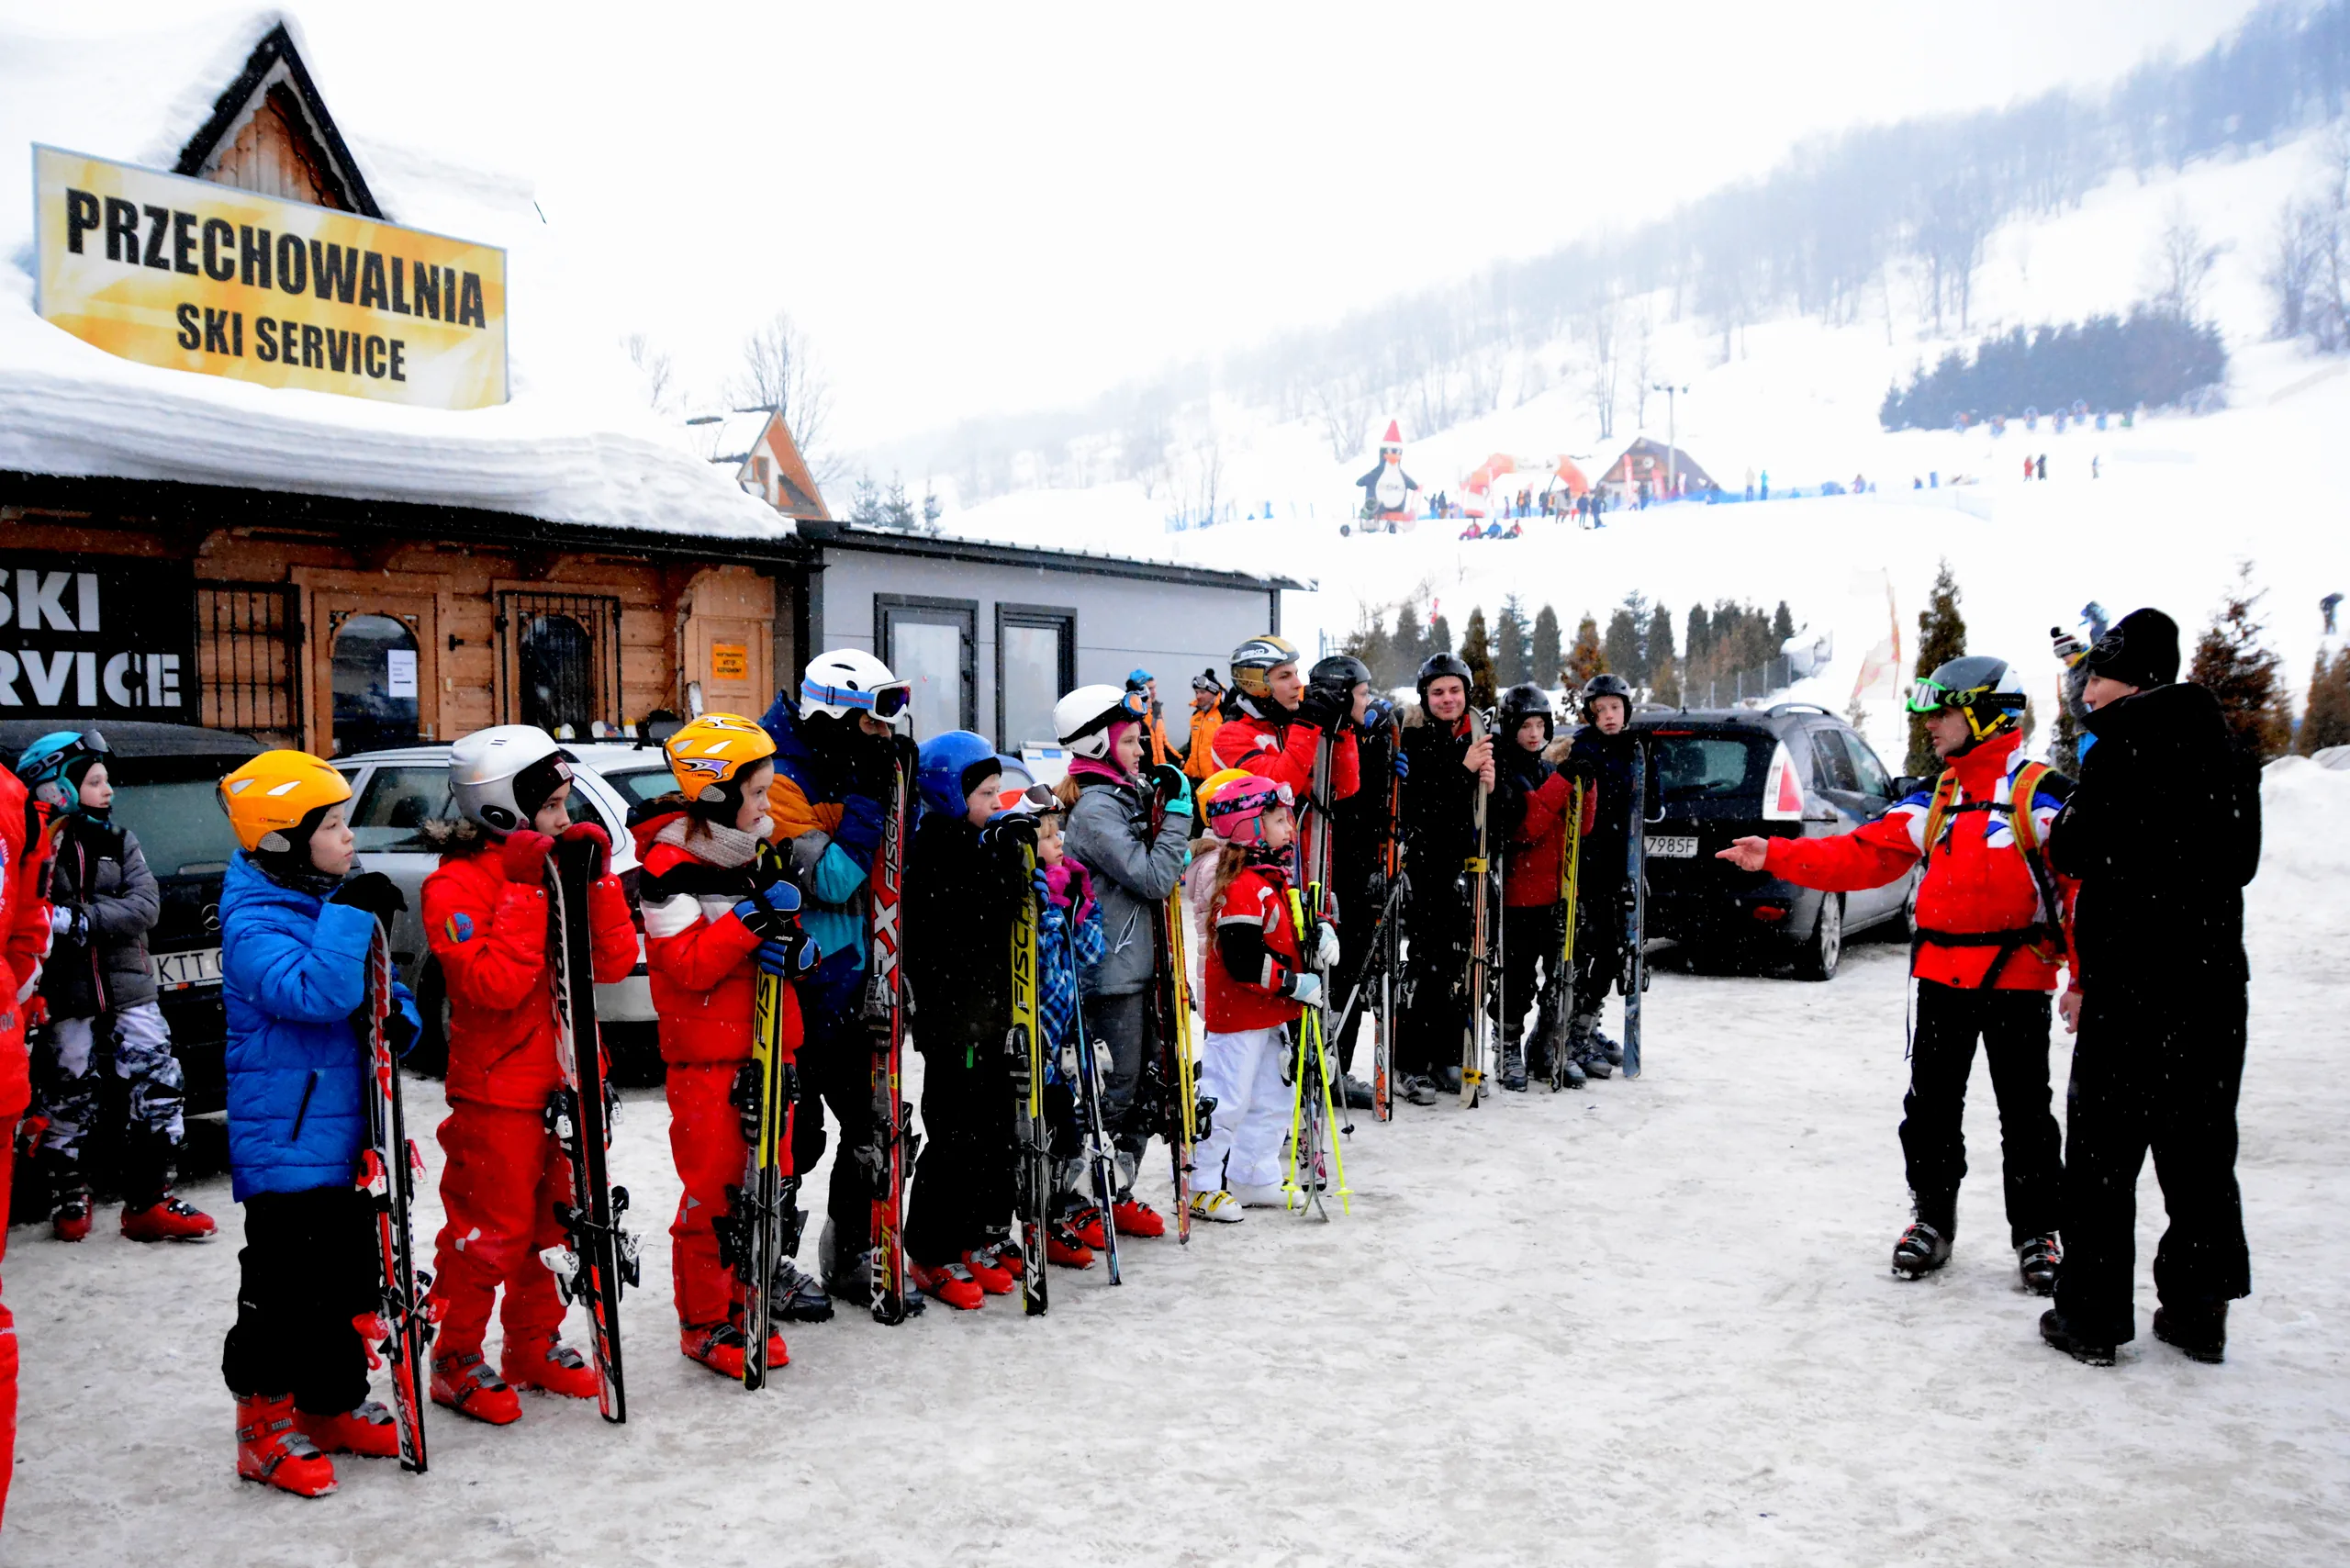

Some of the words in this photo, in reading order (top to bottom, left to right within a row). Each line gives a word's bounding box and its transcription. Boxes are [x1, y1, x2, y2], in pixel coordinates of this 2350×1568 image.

[66, 187, 487, 330] PRZECHOWALNIA
[176, 303, 243, 357] SKI
[255, 316, 407, 382] SERVICE
[884, 778, 900, 893] FISCHE
[1563, 787, 1577, 881] FISCHE
[1648, 837, 1696, 853] 7985F
[157, 952, 204, 983] KTT
[755, 974, 771, 1050] FIS
[870, 1246, 885, 1313] XTR
